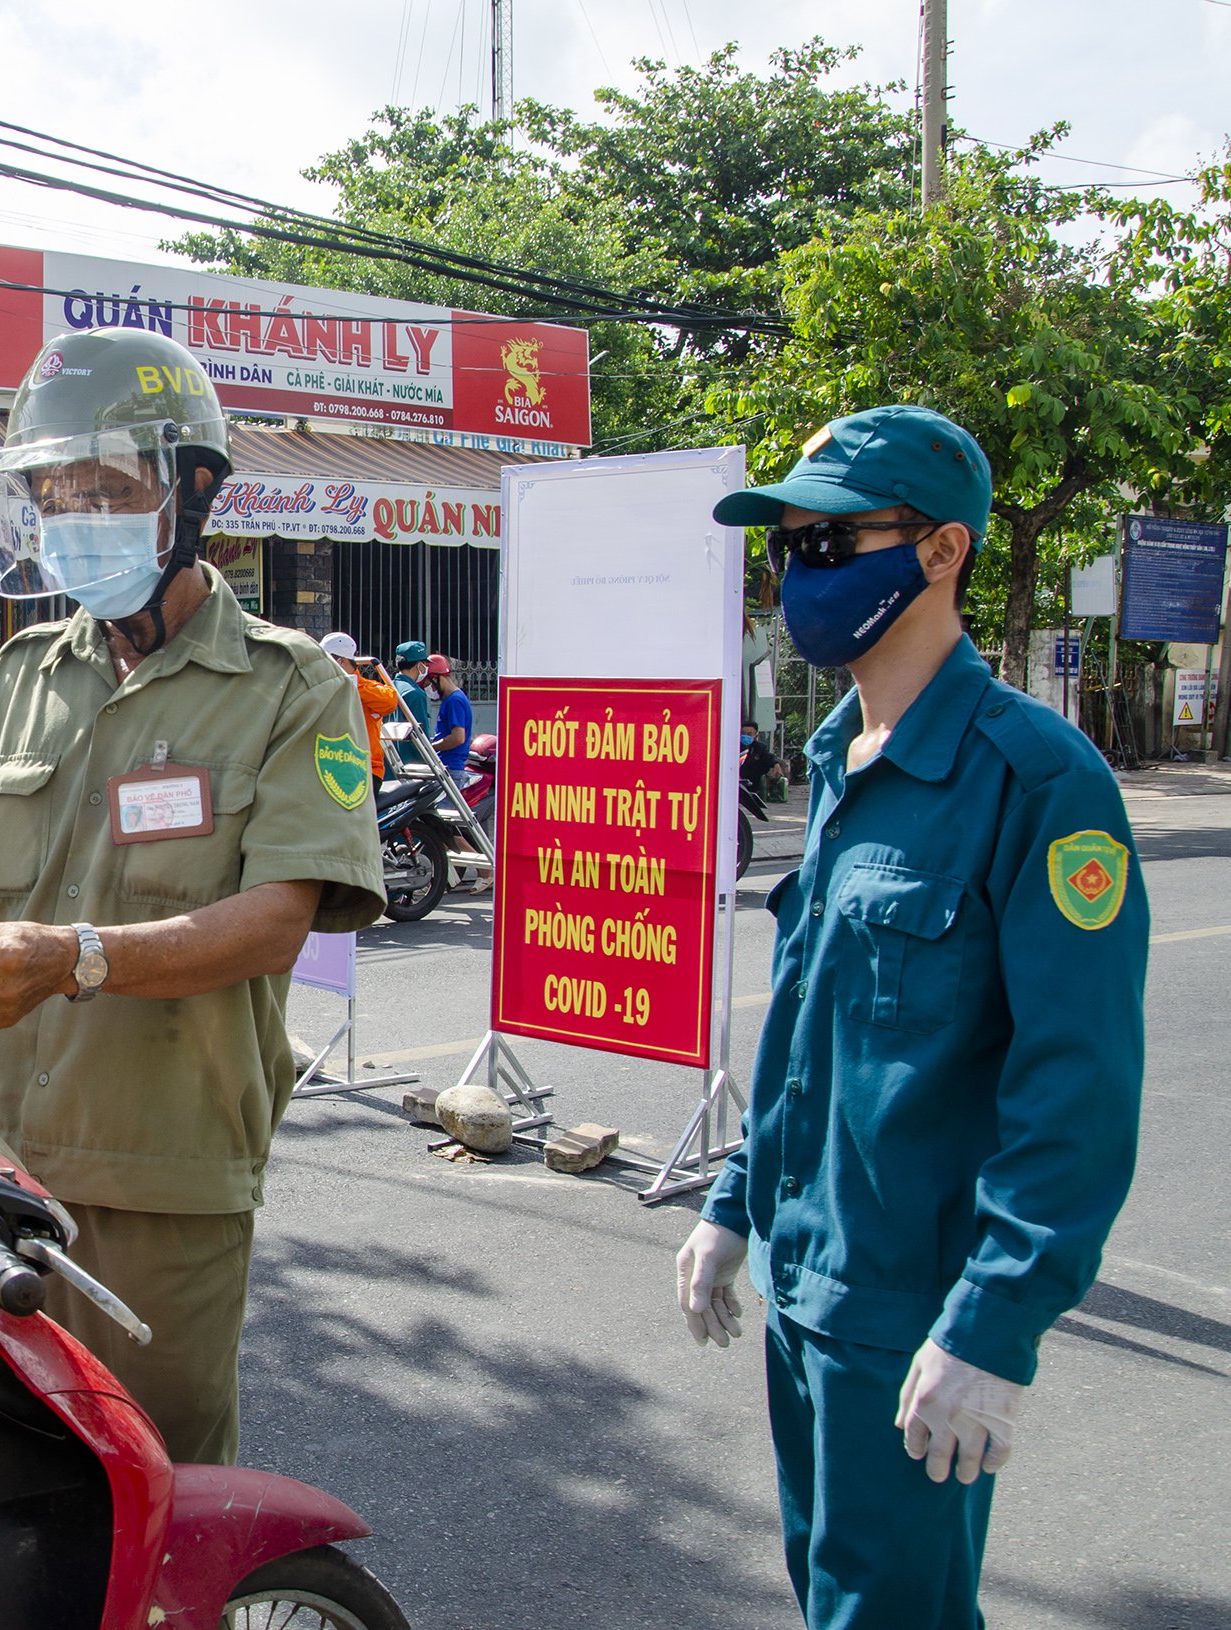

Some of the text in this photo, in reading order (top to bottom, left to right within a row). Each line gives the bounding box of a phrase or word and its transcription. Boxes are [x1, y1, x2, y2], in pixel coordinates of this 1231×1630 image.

[64, 285, 440, 375] QUÁN KHÁNH LY
[61, 368, 93, 377] VICTORY
[240, 362, 273, 384] DÂN
[286, 368, 303, 388] CÀ
[304, 371, 325, 390] PHÊ
[334, 375, 355, 393] GIẢI
[357, 378, 384, 396] KHÁT
[392, 382, 423, 401] NƯỚC
[425, 385, 444, 404] MÍA
[313, 402, 327, 413] ĐT:
[328, 403, 384, 419] 0798.200.668
[391, 410, 444, 425] 0784.276.810
[495, 405, 551, 428] SAIGON
[514, 396, 532, 409] BIA
[210, 481, 317, 519] Khánh
[320, 482, 369, 526] Ly
[372, 490, 466, 541] QUÁN
[211, 519, 224, 529] ĐC:
[225, 520, 240, 530] 335
[282, 522, 301, 532] TP.VT
[309, 524, 321, 533] ĐT:
[321, 524, 366, 536] 0798.200.668
[523, 705, 690, 764] CHỐT ĐẢM BẢO
[510, 779, 702, 841] AN NINH TRẬT TỰ
[537, 838, 666, 896] VÀ AN TOÀN
[525, 902, 677, 965] PHÒNG CHỐNG
[544, 973, 651, 1026] COVID -19
